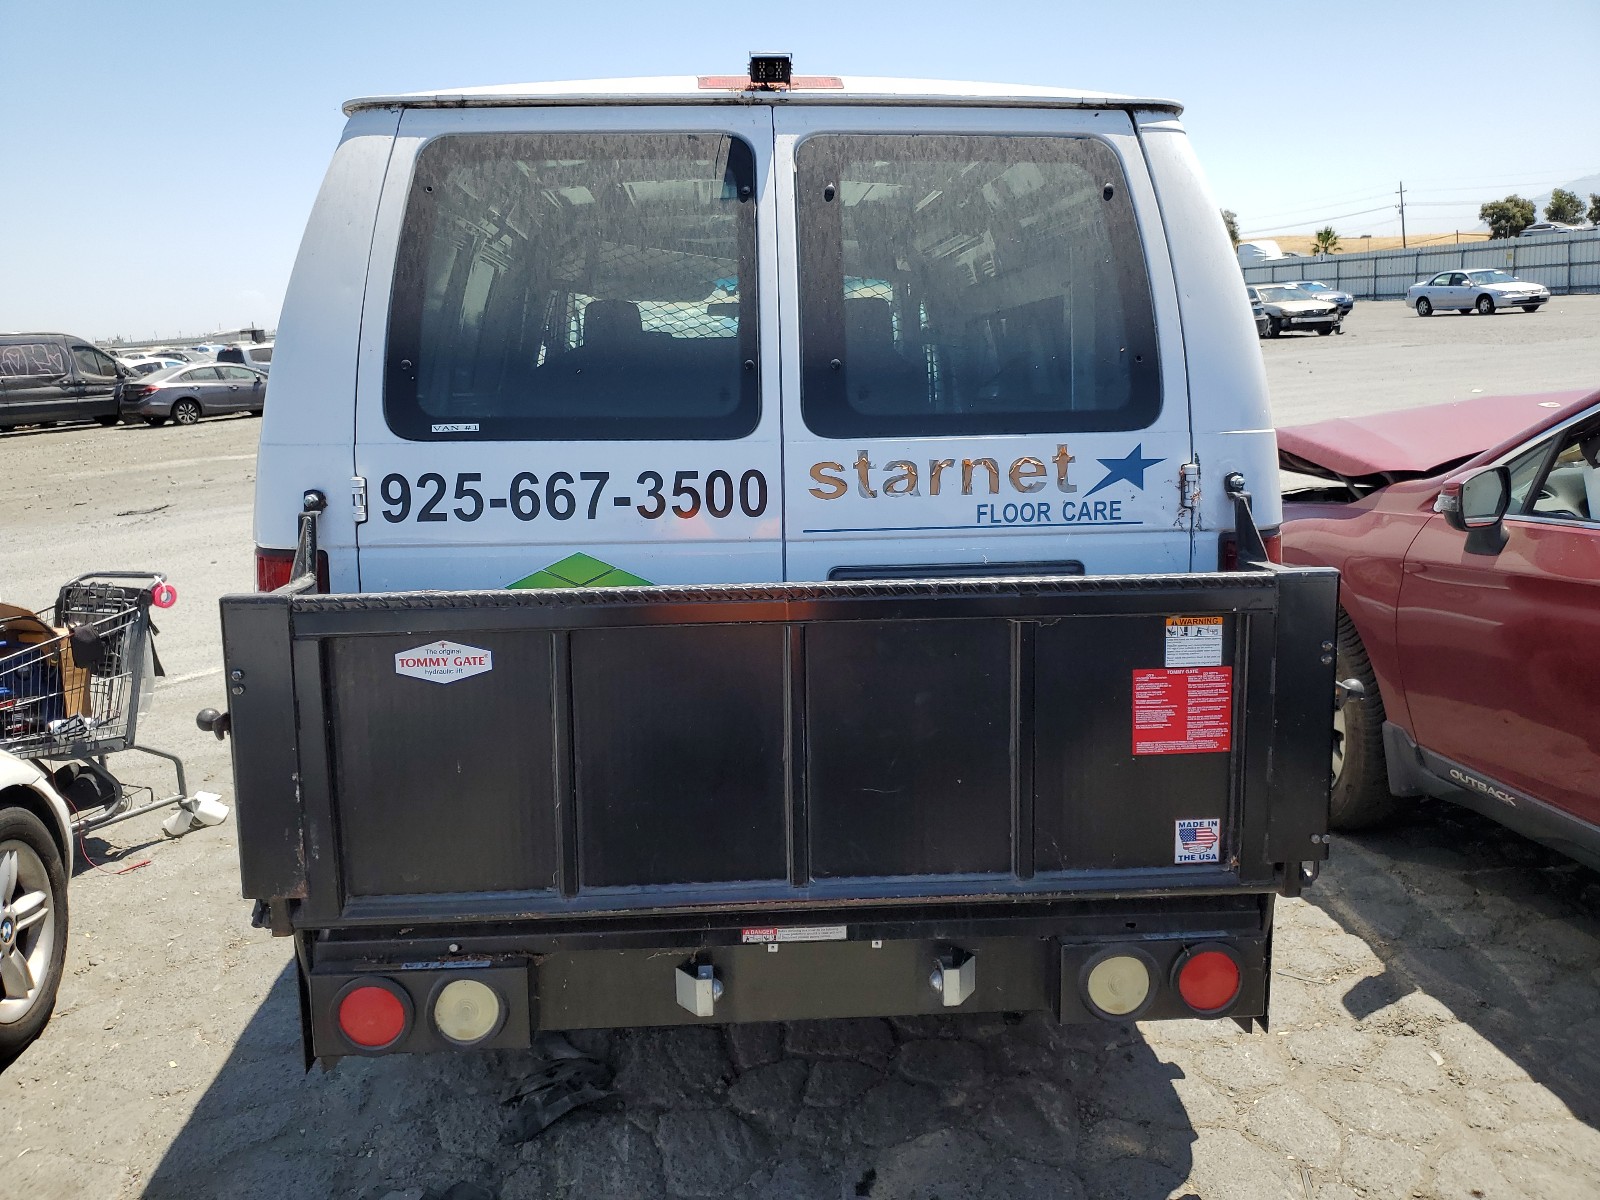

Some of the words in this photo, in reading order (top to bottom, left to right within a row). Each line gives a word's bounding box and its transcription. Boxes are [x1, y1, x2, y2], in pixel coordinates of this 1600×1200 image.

[808, 443, 1078, 500] starnet
[380, 469, 769, 524] 925-667-3500
[976, 503, 1052, 524] FLOOR
[1062, 500, 1123, 521] CARE
[1179, 617, 1219, 625] WARNING
[399, 657, 448, 668] TOMMY
[453, 656, 486, 667] GATE
[1449, 769, 1517, 807] OUTBACK
